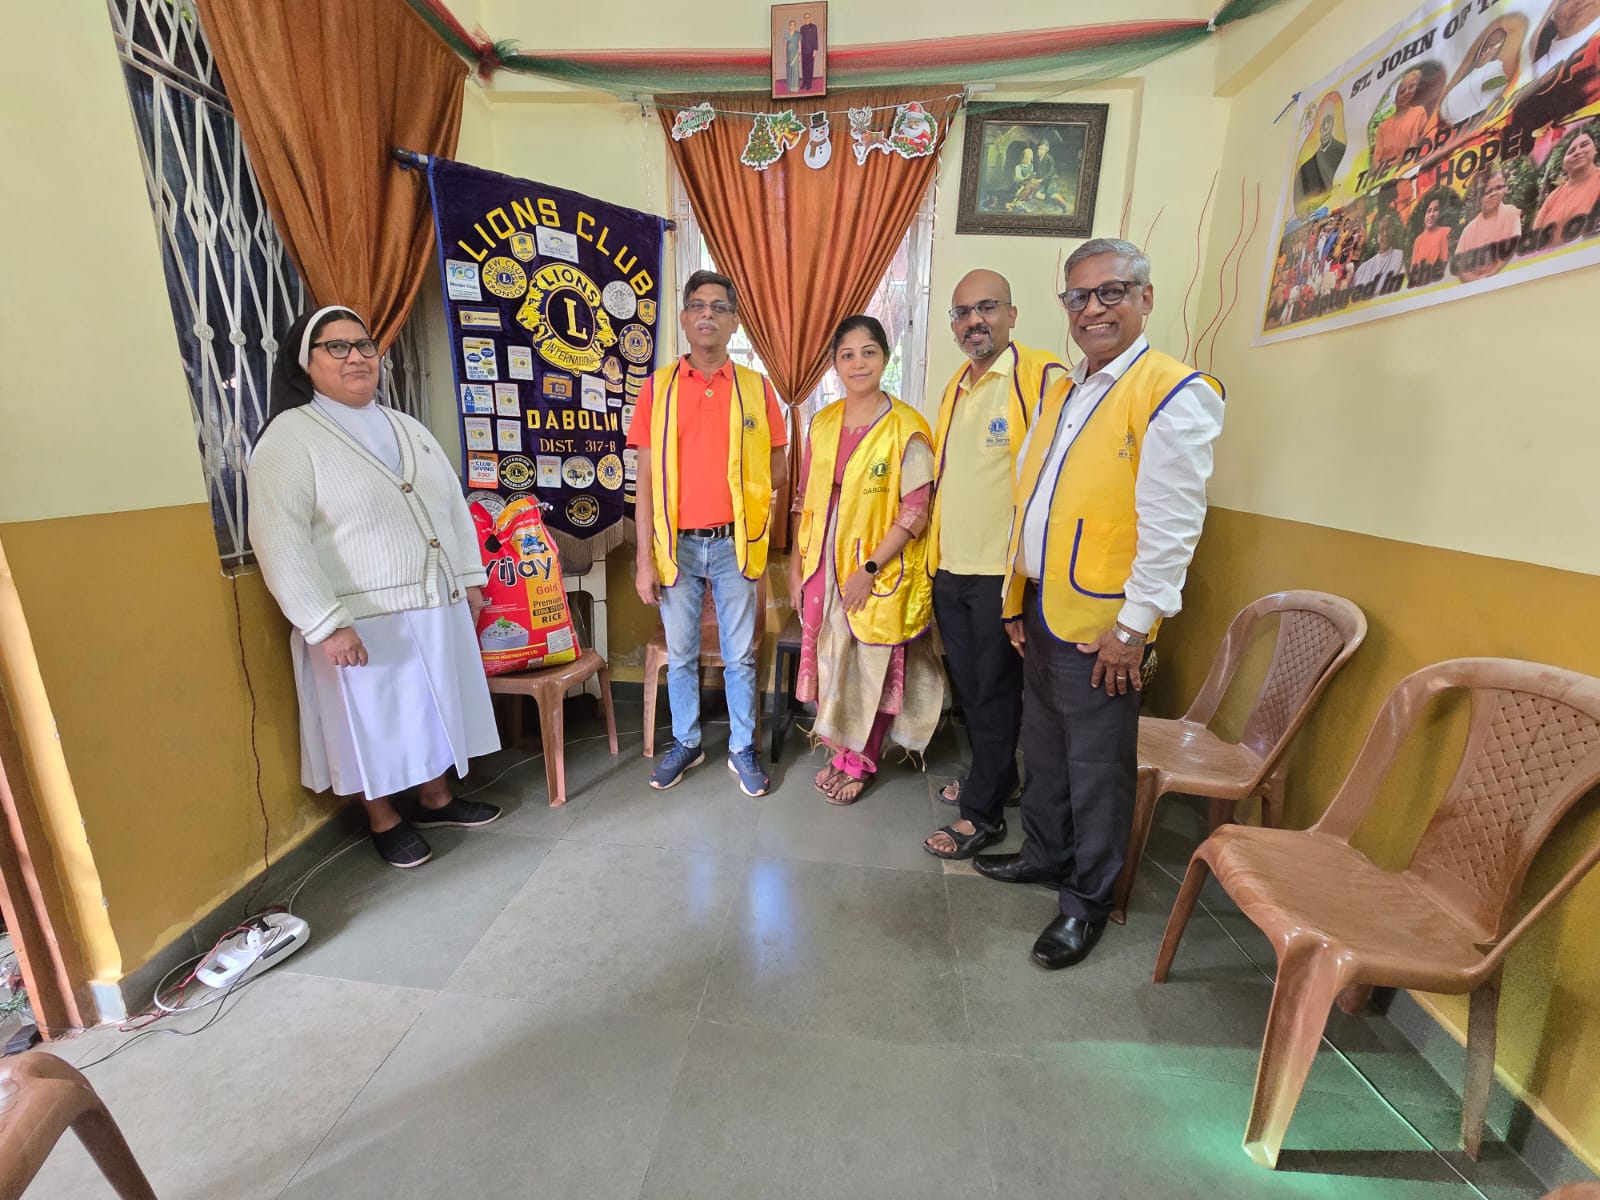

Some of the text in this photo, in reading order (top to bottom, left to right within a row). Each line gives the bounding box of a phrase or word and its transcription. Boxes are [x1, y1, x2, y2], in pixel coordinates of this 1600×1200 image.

[1376, 26, 1438, 80] JOHN
[1442, 2, 1473, 40] OF
[1434, 127, 1524, 190] HOPE
[457, 197, 654, 296] LIONS CLUB
[504, 259, 525, 281] CLUB
[485, 279, 525, 298] SPONSOR
[540, 268, 600, 304] LIONS
[563, 297, 588, 341] L
[540, 438, 617, 453] DIST. 317-B
[536, 583, 558, 595] Gold
[541, 612, 562, 624] RICE
